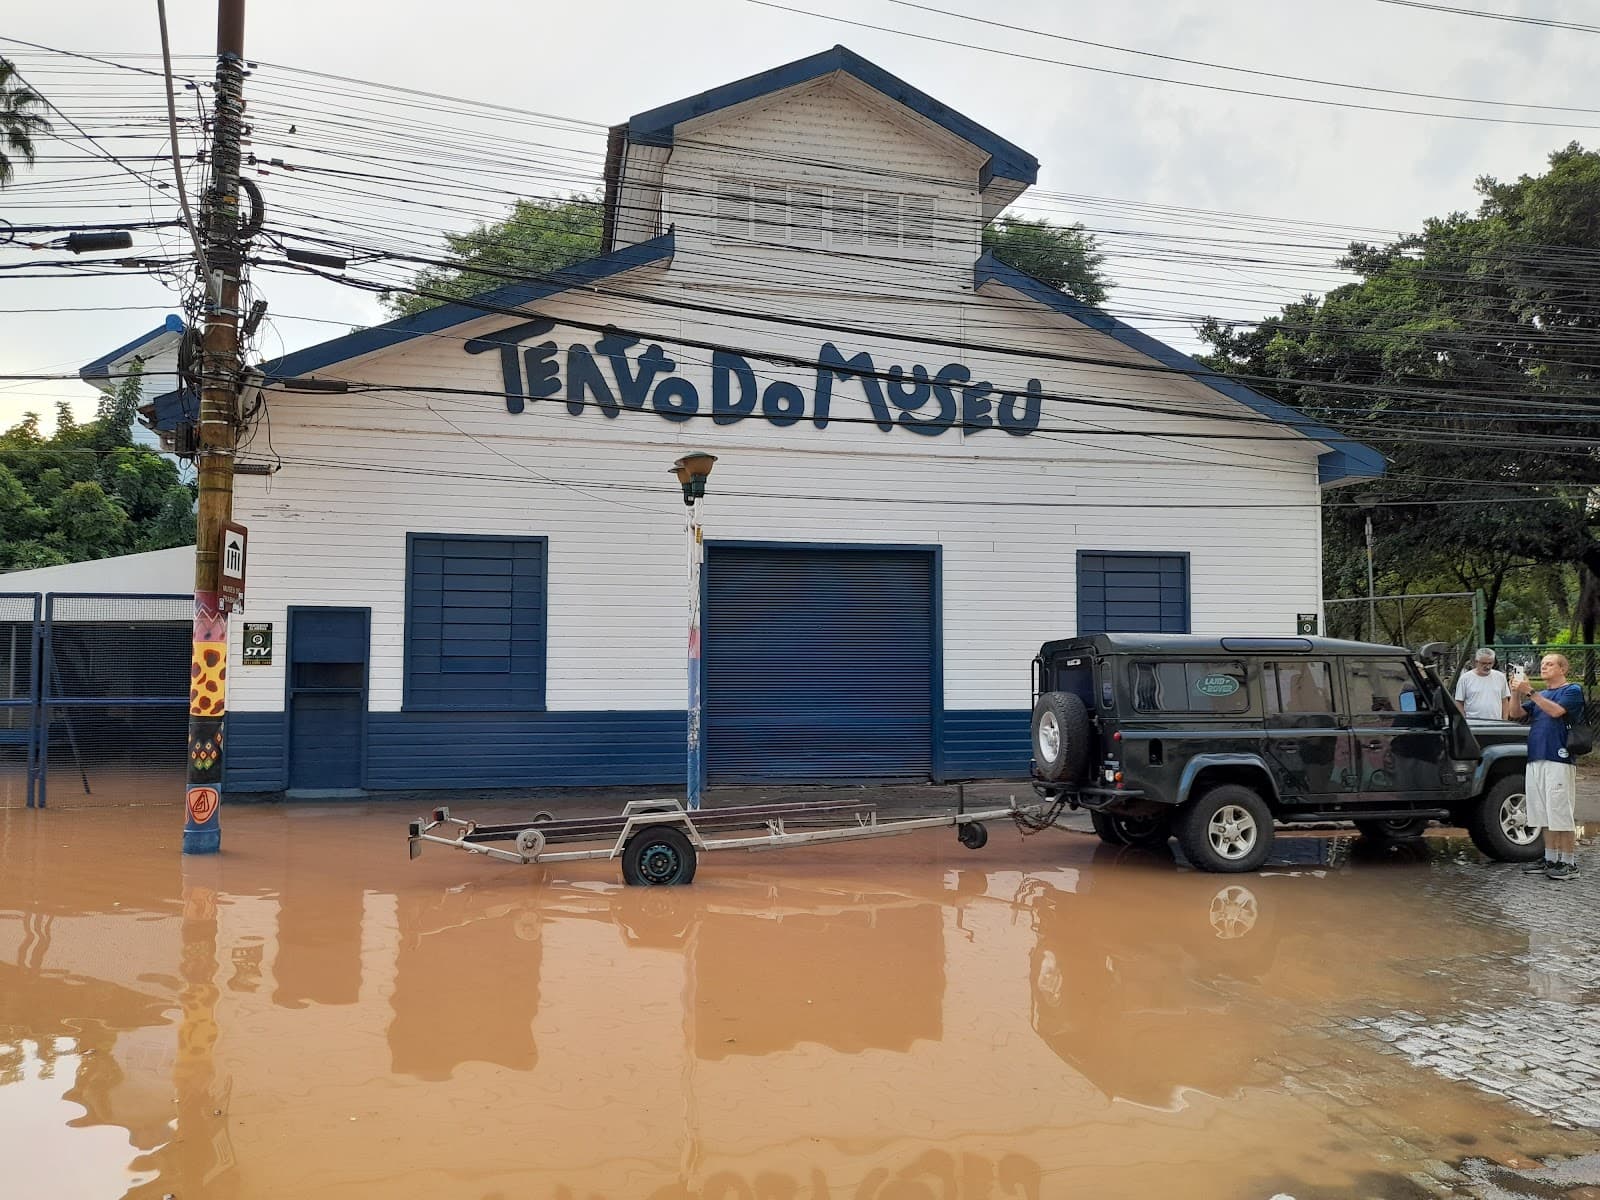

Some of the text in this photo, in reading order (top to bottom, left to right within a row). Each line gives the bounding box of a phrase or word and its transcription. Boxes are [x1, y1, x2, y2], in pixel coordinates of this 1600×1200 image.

[713, 350, 805, 427] DO
[813, 342, 1041, 437] MUSEU
[243, 647, 271, 656] STV
[1204, 677, 1225, 685] LAND
